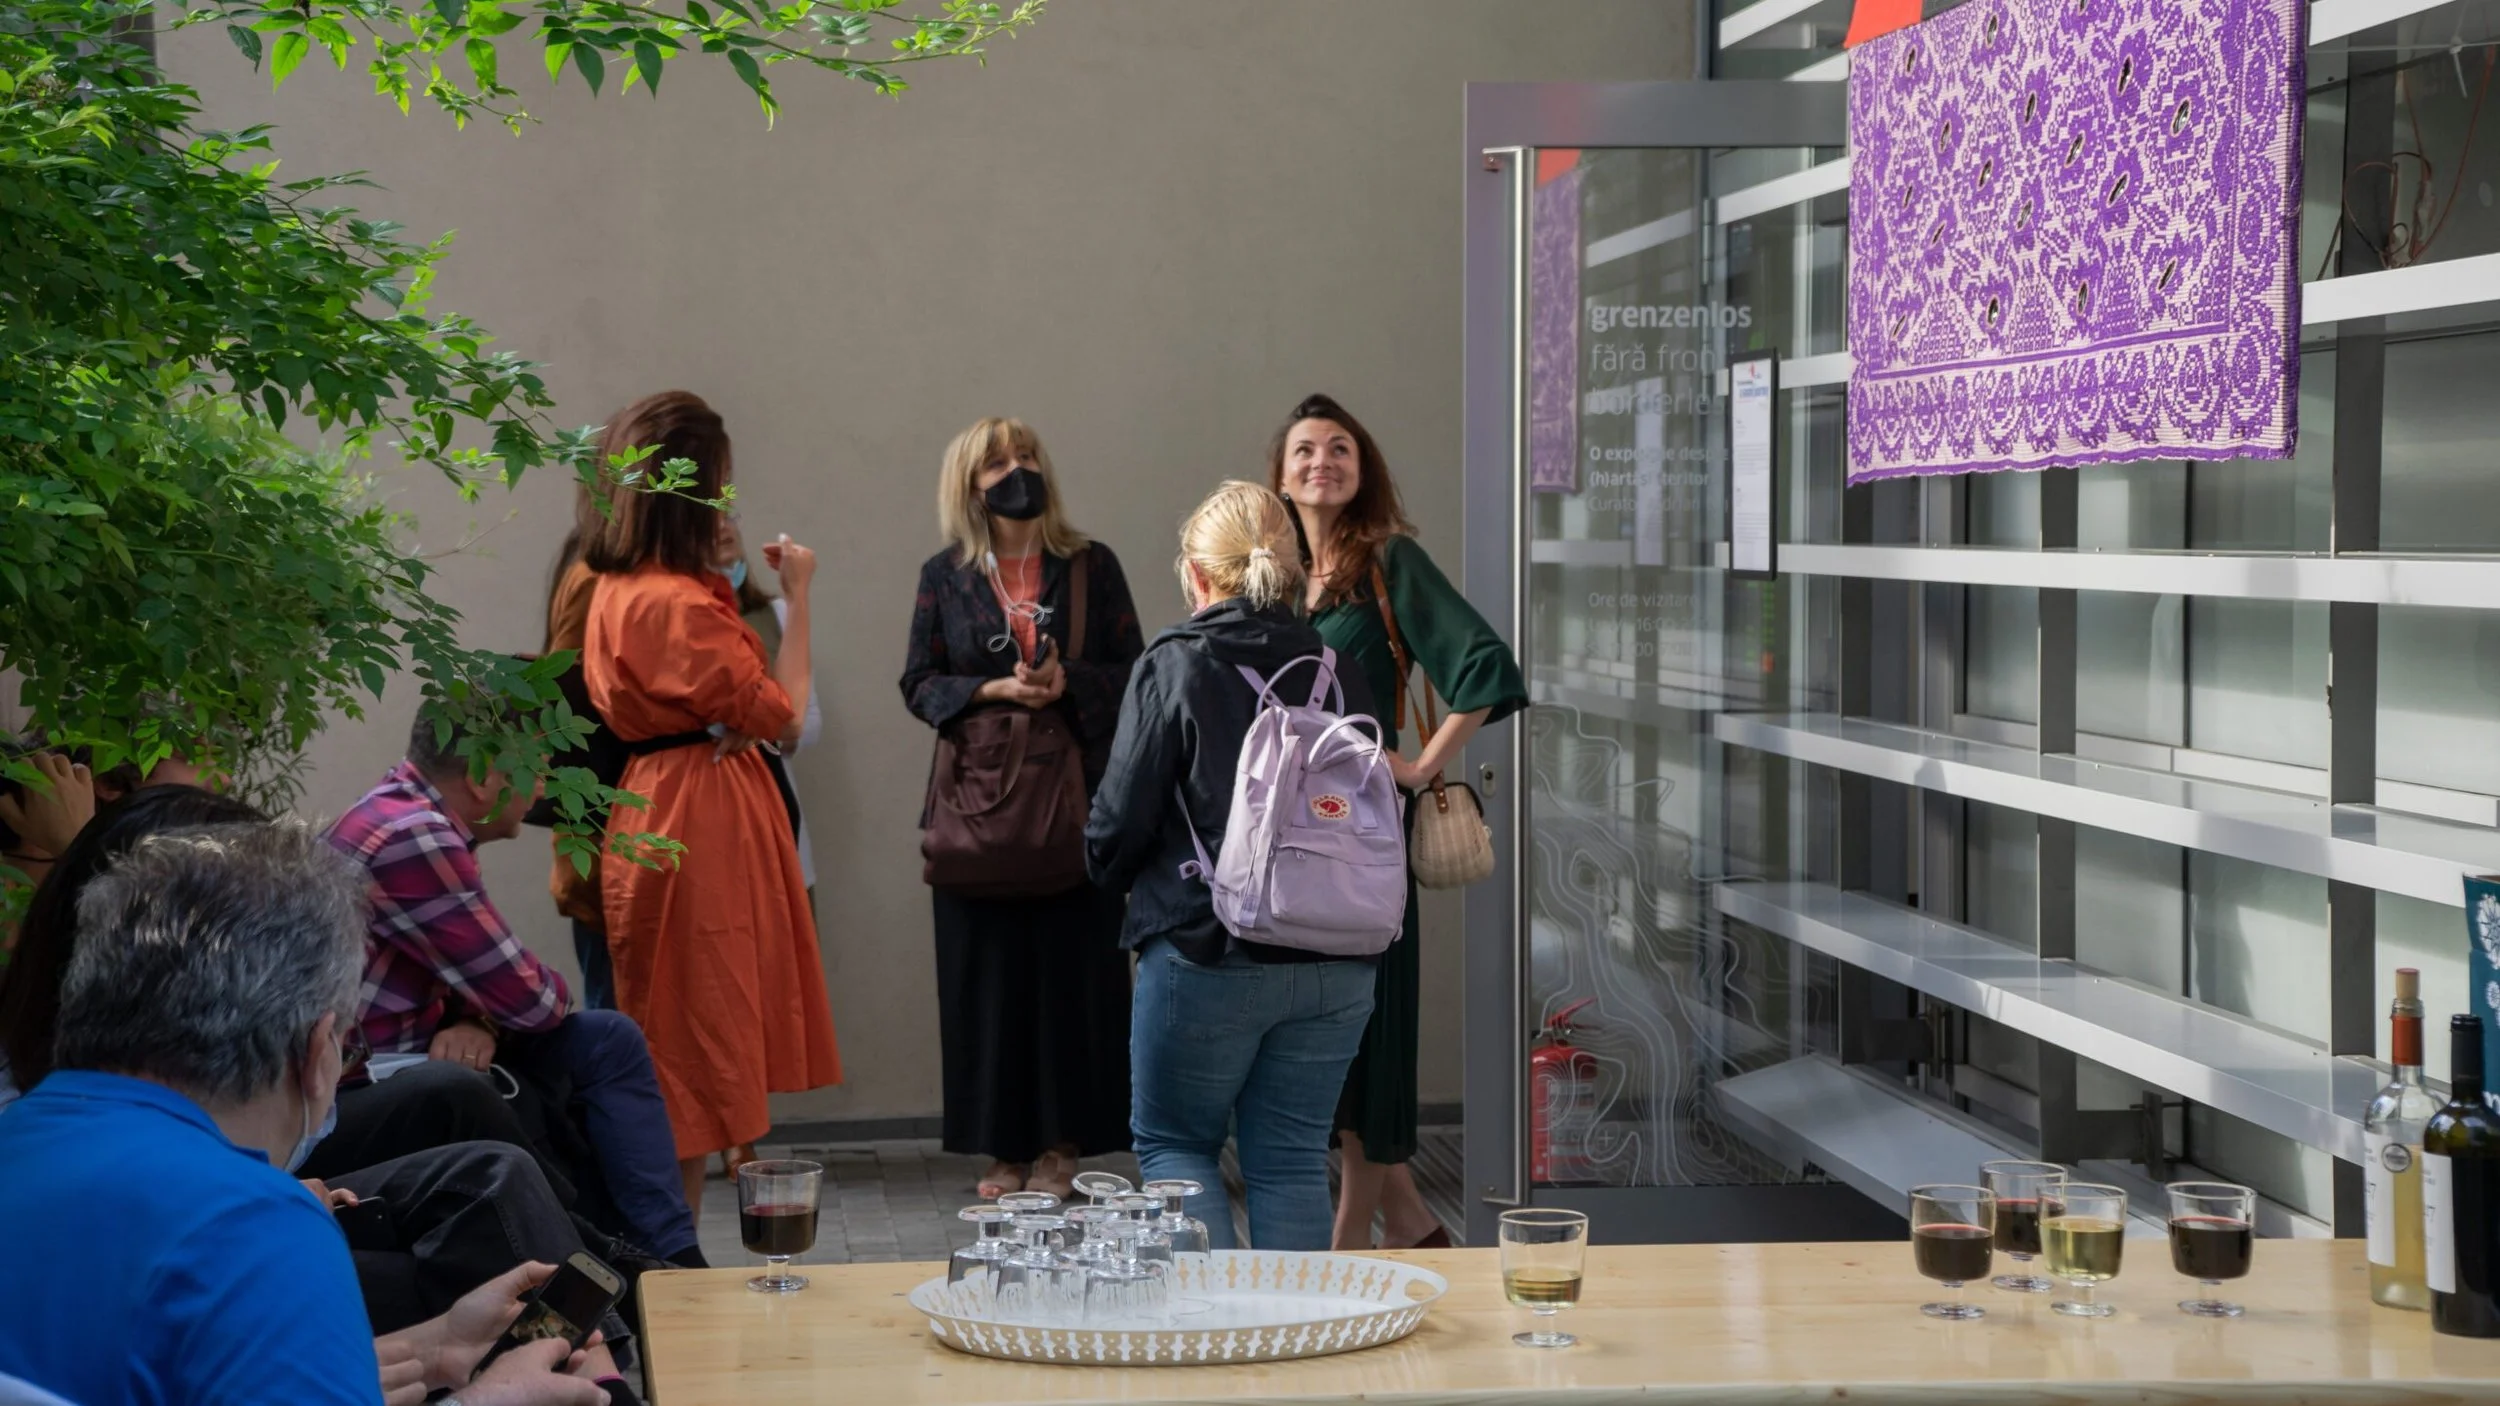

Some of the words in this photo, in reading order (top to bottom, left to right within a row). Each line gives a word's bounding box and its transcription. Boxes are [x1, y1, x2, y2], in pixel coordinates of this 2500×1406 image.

[1591, 300, 1752, 333] grenzenlos
[1592, 343, 1646, 372] fără
[1590, 446, 1601, 460] O
[1588, 592, 1615, 607] Ore
[1619, 592, 1638, 607] de
